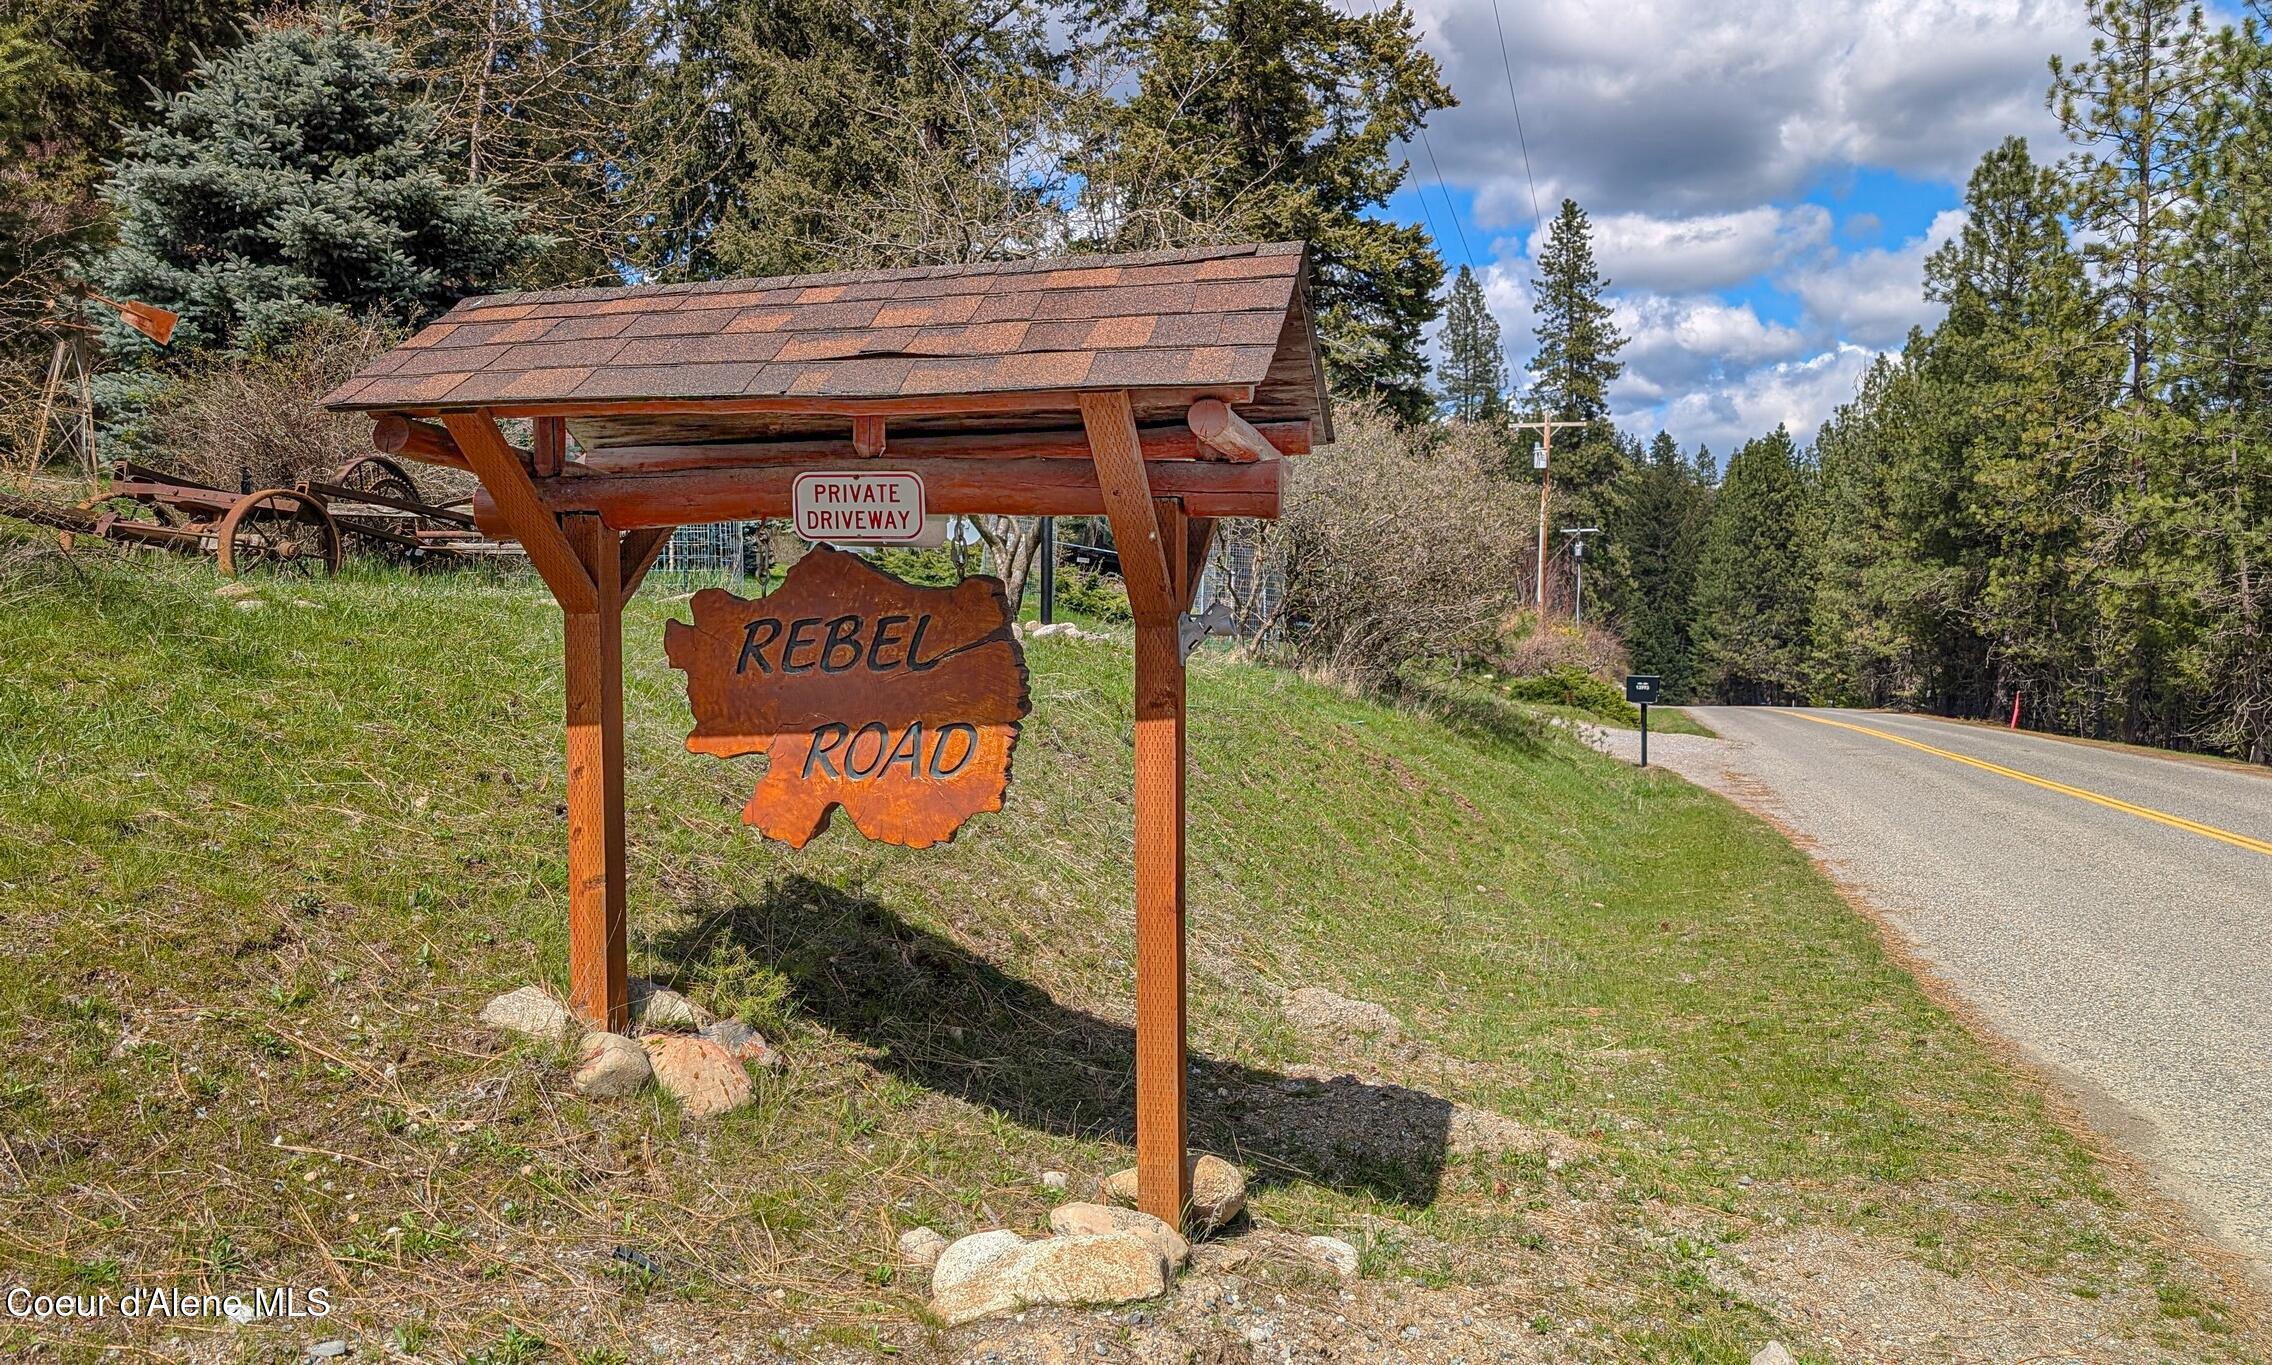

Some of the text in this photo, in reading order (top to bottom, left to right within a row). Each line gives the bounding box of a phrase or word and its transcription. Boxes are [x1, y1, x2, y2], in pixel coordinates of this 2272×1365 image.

[814, 483, 901, 503] PRIVATE
[807, 510, 910, 530] DRIVEWAY
[736, 614, 940, 675] REBEL
[801, 720, 978, 781] ROAD
